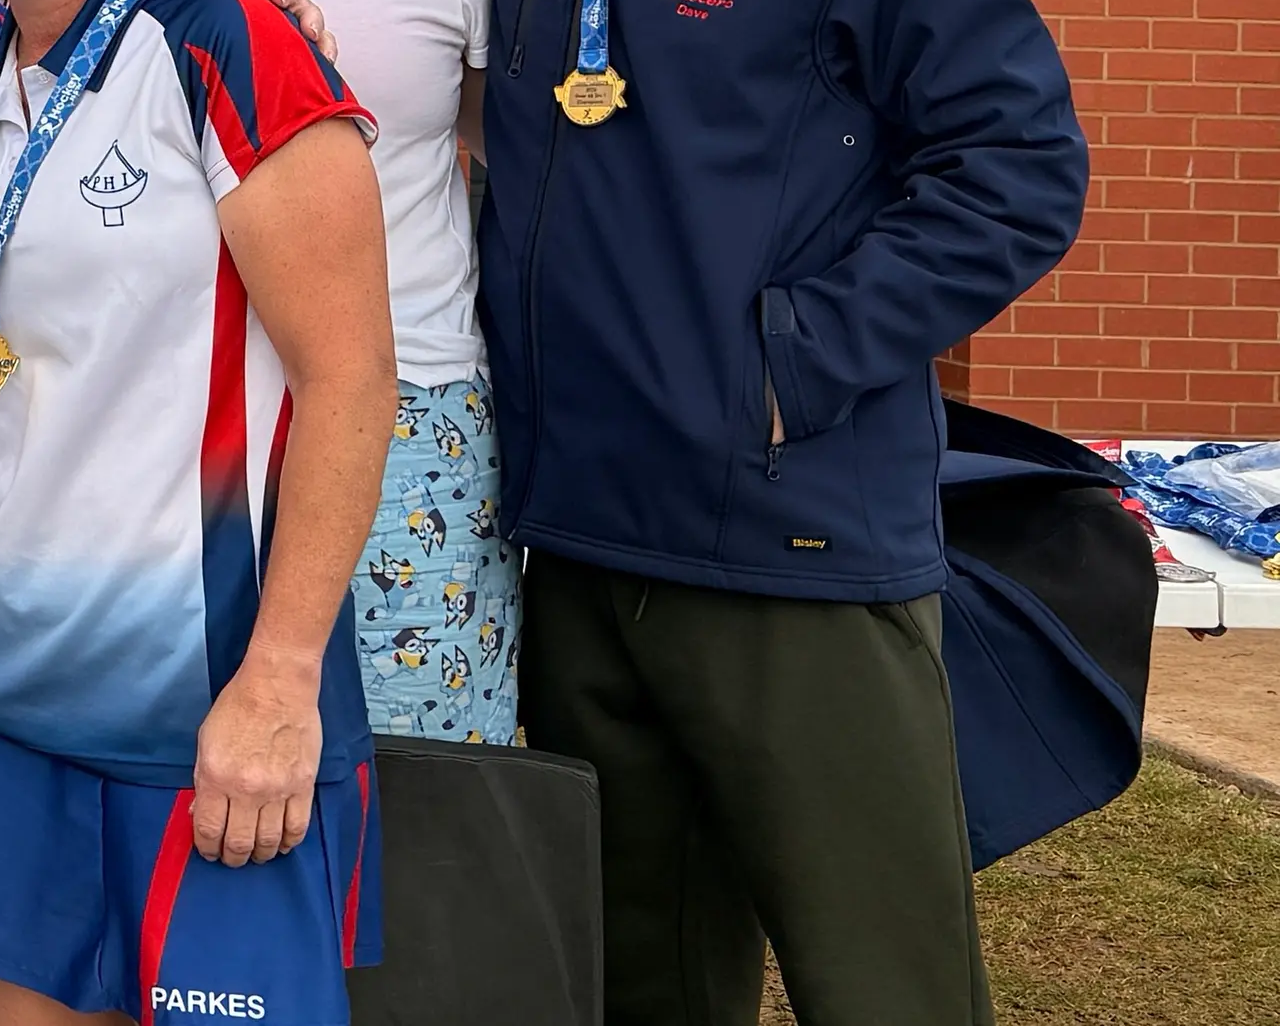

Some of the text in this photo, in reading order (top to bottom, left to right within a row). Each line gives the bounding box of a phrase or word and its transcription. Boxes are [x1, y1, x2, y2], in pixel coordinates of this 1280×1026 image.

[676, 3, 709, 20] Dave
[48, 72, 82, 120] Hockey
[92, 172, 129, 190] PHI
[151, 986, 266, 1020] PARKES
